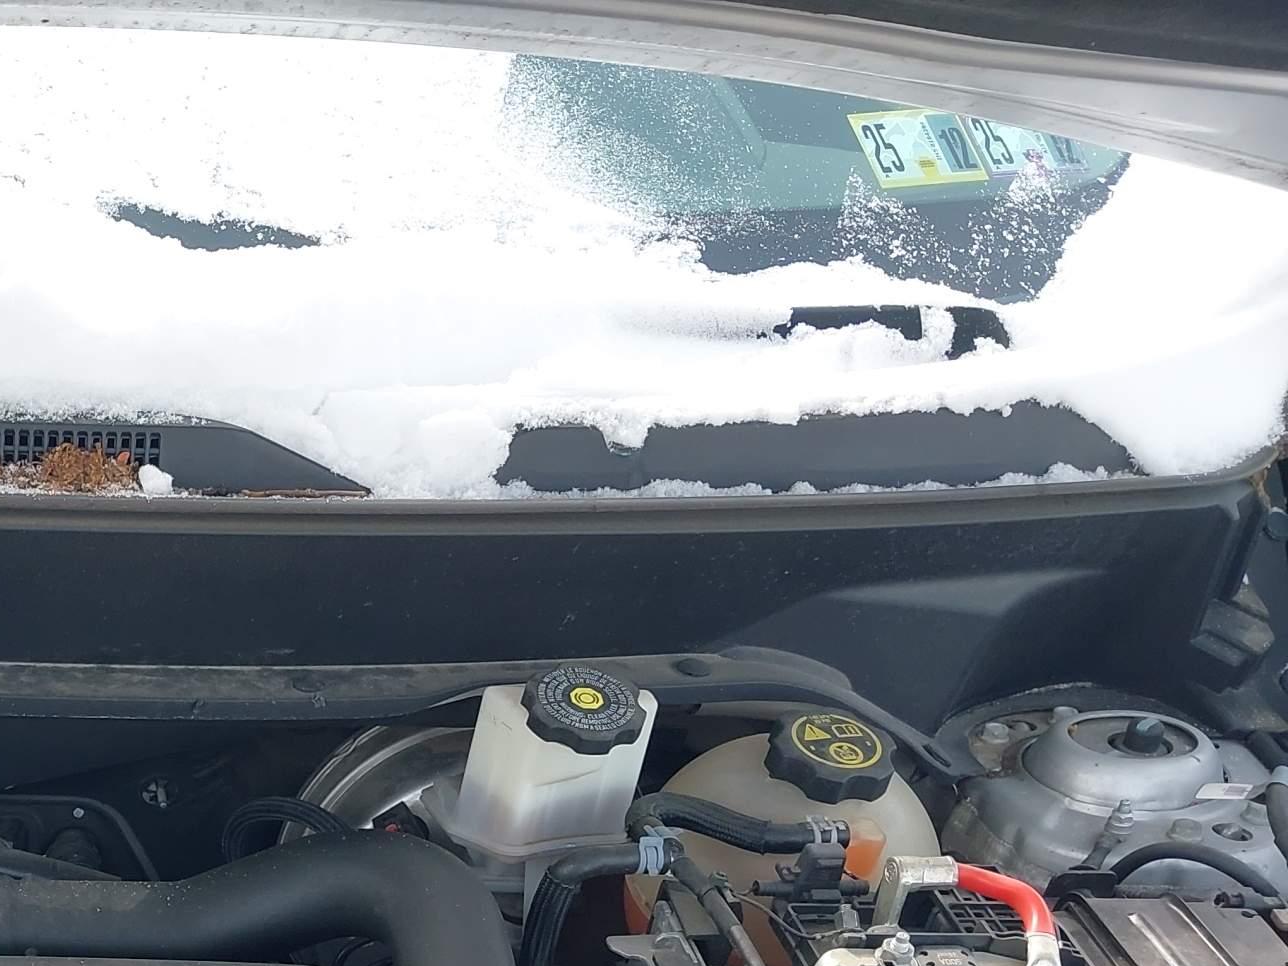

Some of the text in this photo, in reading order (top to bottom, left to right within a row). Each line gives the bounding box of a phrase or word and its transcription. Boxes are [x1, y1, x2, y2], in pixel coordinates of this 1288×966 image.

[861, 123, 906, 174] 25
[938, 127, 978, 169] 12
[970, 118, 1014, 165] 25
